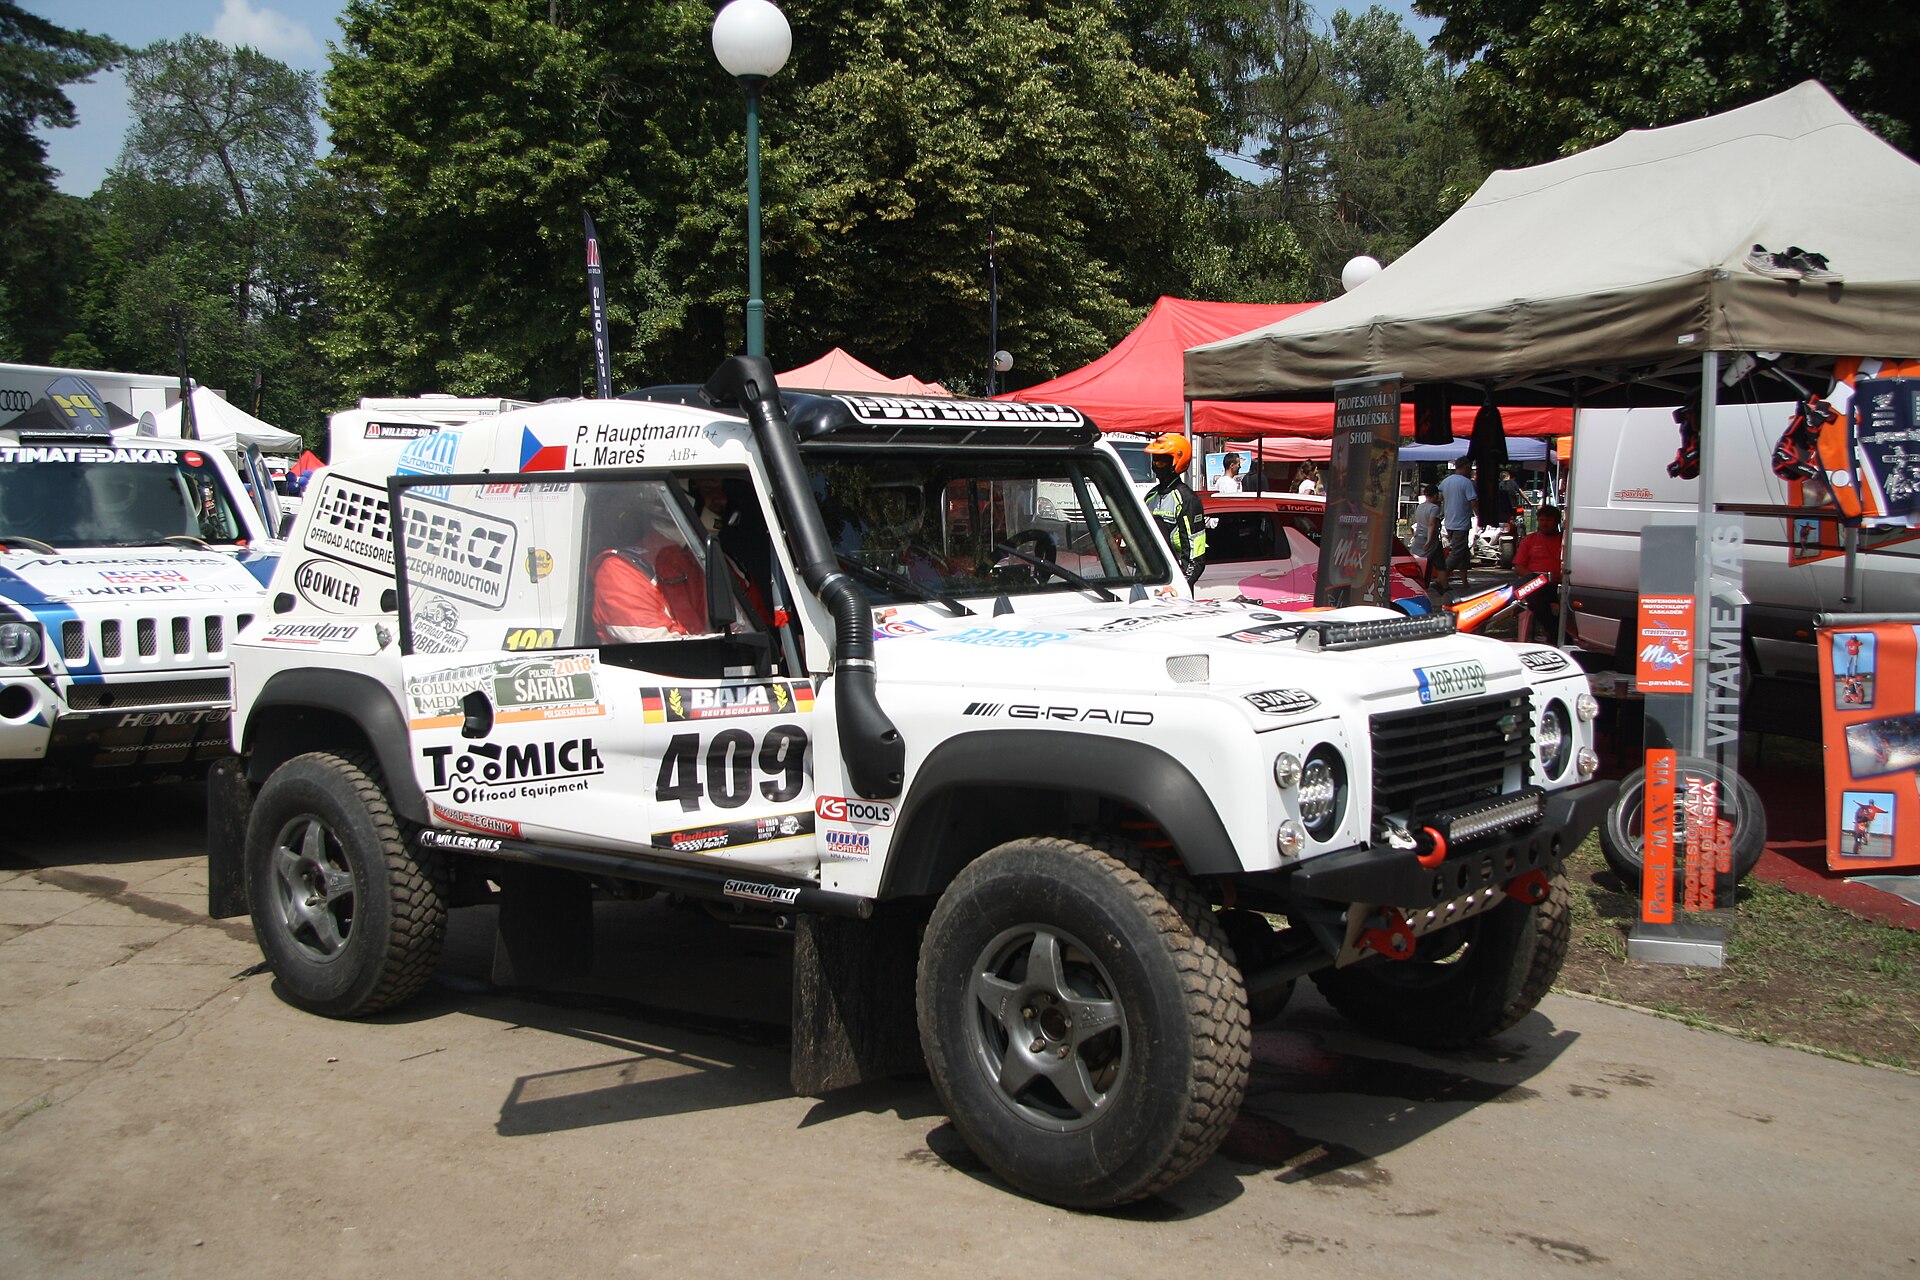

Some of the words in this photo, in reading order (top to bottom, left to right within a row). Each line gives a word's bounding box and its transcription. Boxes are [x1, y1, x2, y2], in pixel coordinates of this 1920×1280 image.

[381, 427, 418, 437] MILLERS
[576, 425, 589, 444] P.
[595, 423, 701, 446] Hauptmann
[0, 446, 178, 464] TIMATEDAKAR
[401, 456, 453, 474] AUTOMOTIVE
[573, 448, 587, 467] L.
[593, 444, 646, 466] Mareš
[311, 527, 343, 550] OFFROAD
[344, 538, 395, 564] ACCESSORIES
[304, 568, 361, 607] BOWLER
[435, 566, 500, 597] PRODUCTION
[1518, 578, 1544, 597] MOTUL
[268, 623, 359, 640] speedpro
[415, 622, 444, 640] OFFROAD
[442, 633, 462, 648] PARK
[529, 668, 554, 678] POLSKIE
[554, 657, 592, 676] 2018
[1521, 651, 1563, 667] EVANS
[411, 680, 486, 697] COLUMNA
[515, 676, 576, 702] SAFARI
[690, 684, 770, 708] BAJA
[1422, 691, 1430, 701] CZ
[1430, 669, 1455, 695] 10R
[421, 696, 461, 710] MEDI
[1247, 688, 1311, 707] EVANS
[544, 706, 600, 719] POLSKIESAFARI.COM
[701, 705, 770, 718] DEUTSCHLAND
[111, 743, 193, 754] PROFESSIONAL
[195, 739, 231, 748] TOOLS
[655, 723, 808, 813] 409
[1651, 756, 1670, 788] Vik
[453, 787, 516, 804] Offroad
[521, 779, 588, 799] Equipment
[820, 798, 847, 818] KS
[846, 803, 890, 822] TOOLS
[436, 834, 478, 850] MILLERS
[478, 839, 502, 852] OILS
[671, 829, 728, 843] Gladiator
[826, 832, 869, 847] auto
[1684, 777, 1701, 912] PROFESIONÁLNÍ
[1698, 781, 1717, 909] KASKADÉRSKÁ
[1716, 819, 1733, 873] SHOW
[828, 843, 869, 855] PROFITEAM
[725, 880, 799, 902] speedpro
[1648, 863, 1667, 916] Pavel
